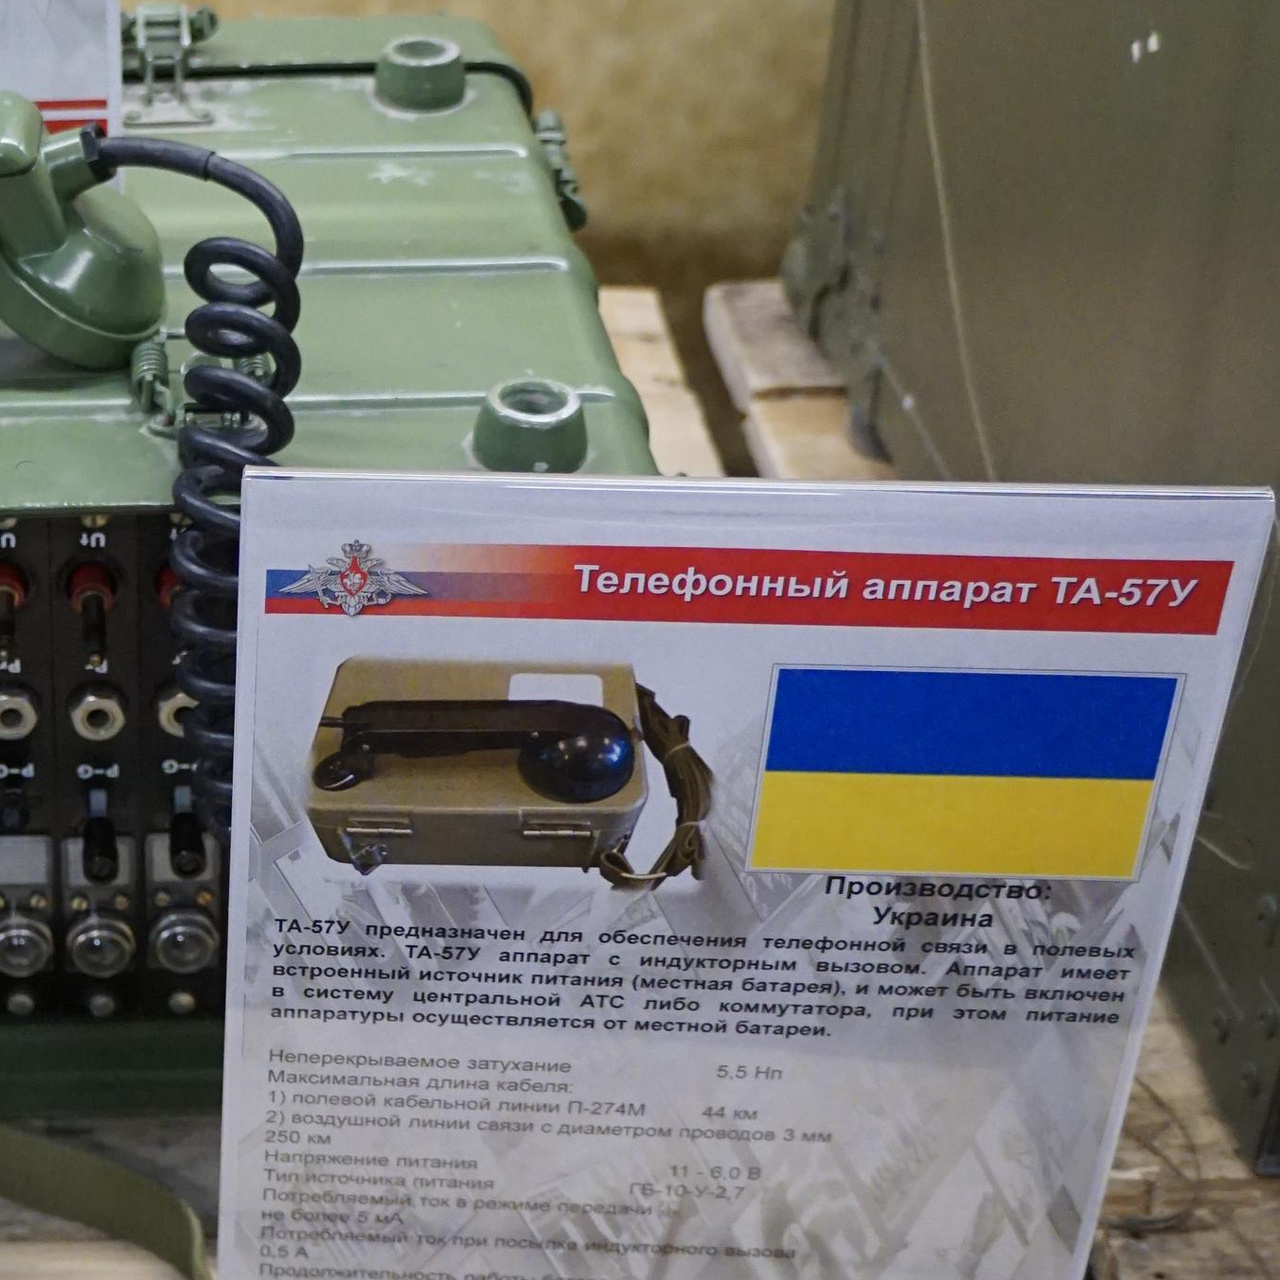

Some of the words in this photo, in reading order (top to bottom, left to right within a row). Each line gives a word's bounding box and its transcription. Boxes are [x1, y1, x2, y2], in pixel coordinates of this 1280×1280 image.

[573, 564, 849, 599] Телефонный
[862, 577, 1038, 604] аппарат
[1052, 576, 1198, 607] ТА-57У
[824, 875, 1053, 902] Производство:
[872, 906, 995, 931] Украина
[274, 914, 351, 935] ТА-57У
[365, 921, 526, 940] предназначен
[539, 927, 583, 944] для
[598, 925, 747, 947] обеспечения
[762, 932, 906, 954] телефонной
[920, 939, 989, 955] связи
[1003, 941, 1019, 956] в
[1032, 942, 1136, 959] полевых
[273, 941, 385, 959] условиях.
[405, 941, 481, 961] ТА-57У
[499, 948, 590, 968] аппарат
[608, 951, 621, 966] с
[639, 952, 797, 974] индукторным
[816, 958, 925, 975] вызовом.
[945, 958, 1043, 982] Аппарат
[1061, 965, 1130, 981] имеет
[272, 963, 411, 983] встроенный
[419, 968, 523, 985] источник
[531, 971, 624, 988] питания
[631, 970, 733, 993] (местная
[741, 974, 846, 998] батарея),
[855, 981, 870, 995] и
[877, 982, 949, 998] может
[956, 980, 1016, 1000] быть
[1024, 986, 1125, 1003] включен
[271, 984, 285, 999] в
[303, 985, 394, 1006] систему
[413, 989, 561, 1009] центральной
[580, 990, 625, 1009] АТС
[644, 993, 700, 1012] либо
[719, 999, 871, 1020] коммутатора,
[892, 1004, 934, 1023] при
[953, 1006, 1007, 1021] этом
[1026, 1008, 1120, 1025] питание
[270, 1007, 405, 1029] аппаратуры
[411, 1011, 596, 1031] осуществляется
[602, 1017, 628, 1031] от
[633, 1016, 728, 1034] местной
[735, 1017, 832, 1040] батареи.
[268, 1065, 420, 1088] Максимальная
[426, 1075, 490, 1091] длина
[496, 1075, 573, 1093] кабеля:
[269, 1046, 460, 1071] Неперекрываемое
[467, 1058, 572, 1077] затухание
[715, 1060, 749, 1080] 5,5
[754, 1062, 784, 1080] Нп
[269, 1087, 286, 1109] 1)
[292, 1090, 377, 1107] полевой
[383, 1091, 491, 1111] кабельной
[497, 1098, 560, 1113] линии
[567, 1096, 646, 1115] П-274М
[702, 1102, 725, 1119] 44
[733, 1106, 758, 1120] км
